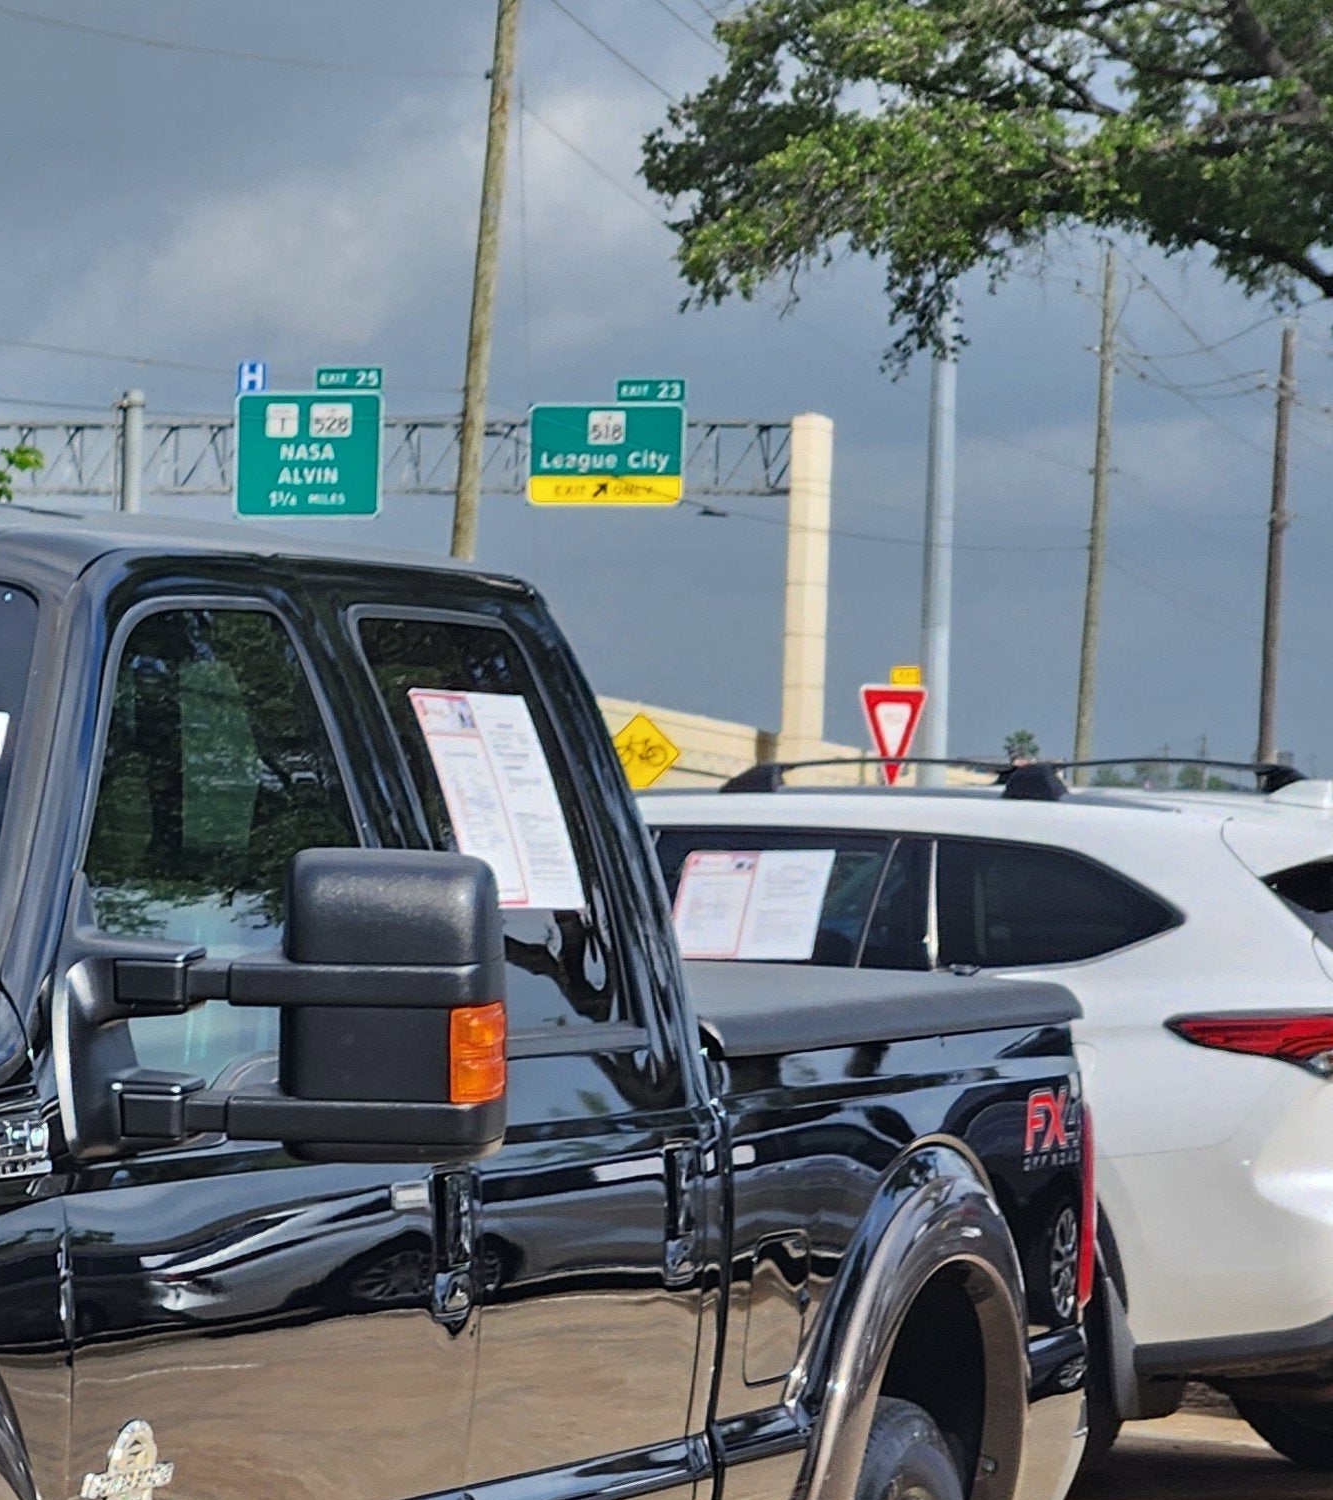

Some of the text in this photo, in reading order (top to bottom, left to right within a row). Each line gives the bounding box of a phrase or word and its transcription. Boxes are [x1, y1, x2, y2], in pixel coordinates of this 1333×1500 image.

[319, 370, 379, 386] EXIT 25
[620, 382, 681, 399] EXIT 23
[314, 416, 349, 434] 528
[590, 422, 623, 441] 518
[279, 443, 335, 461] NASA
[540, 449, 670, 473] League City
[277, 467, 339, 485] ALVIN
[307, 493, 346, 505] MILES
[1024, 1087, 1082, 1156] FX4
